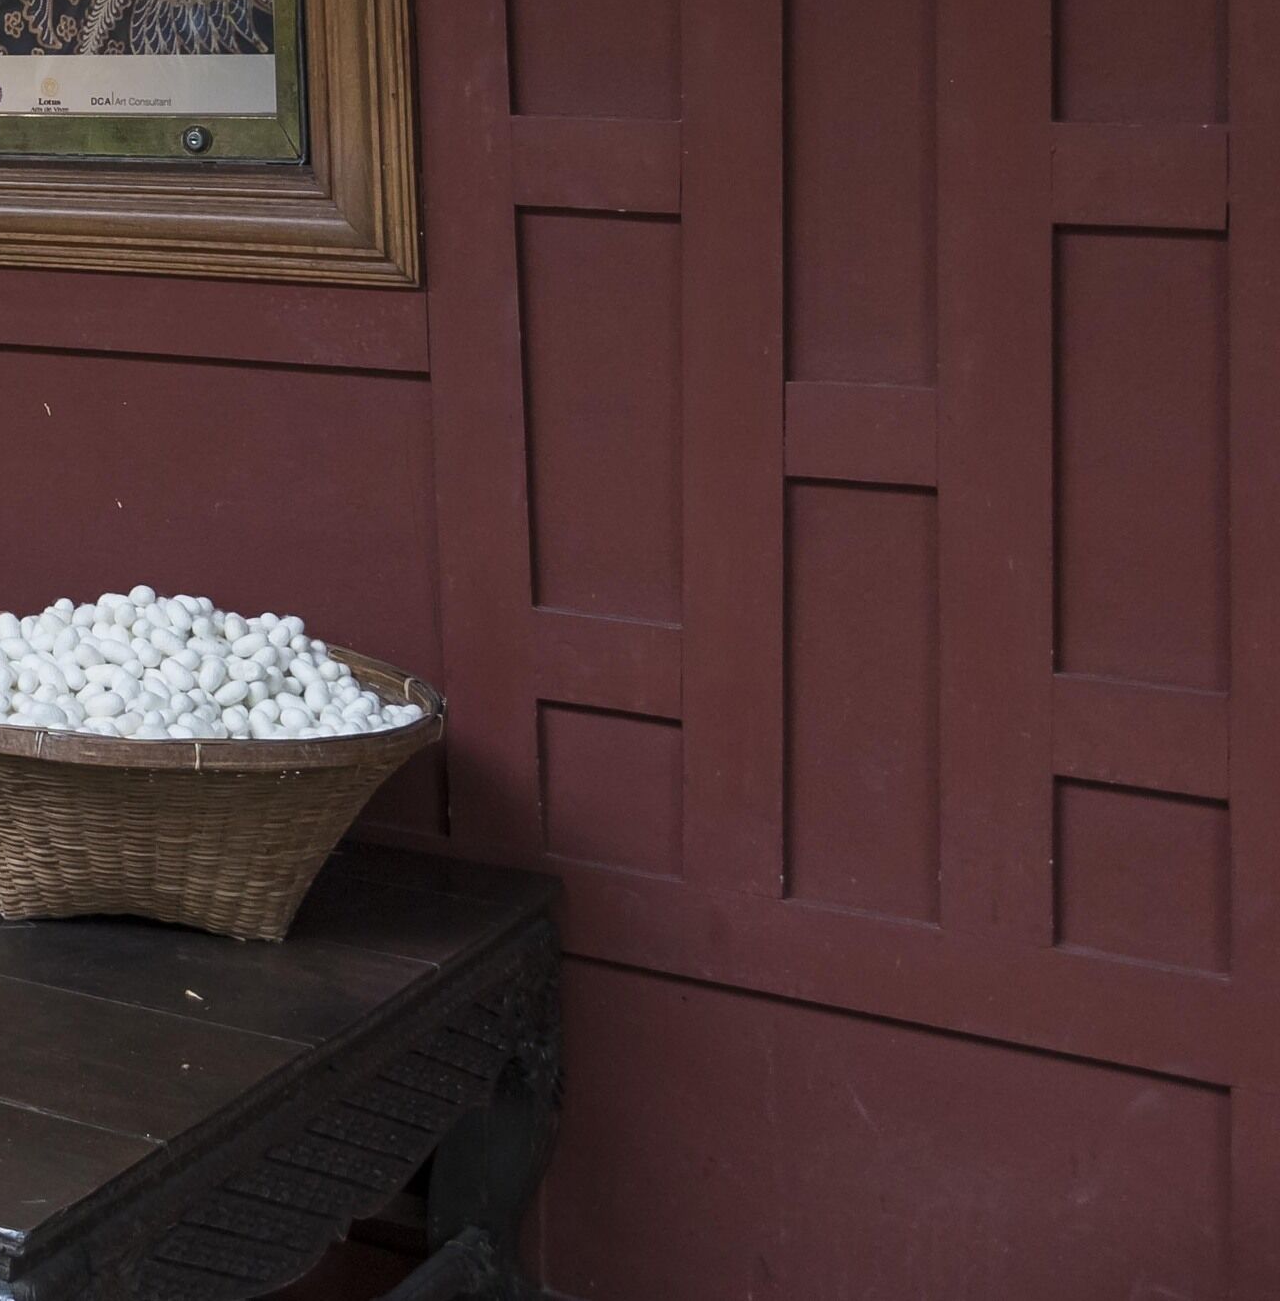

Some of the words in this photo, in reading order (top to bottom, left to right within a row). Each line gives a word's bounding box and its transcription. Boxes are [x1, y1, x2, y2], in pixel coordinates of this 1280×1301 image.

[38, 97, 61, 105] Lotus
[90, 97, 110, 106] DCA
[128, 97, 171, 106] Consultant
